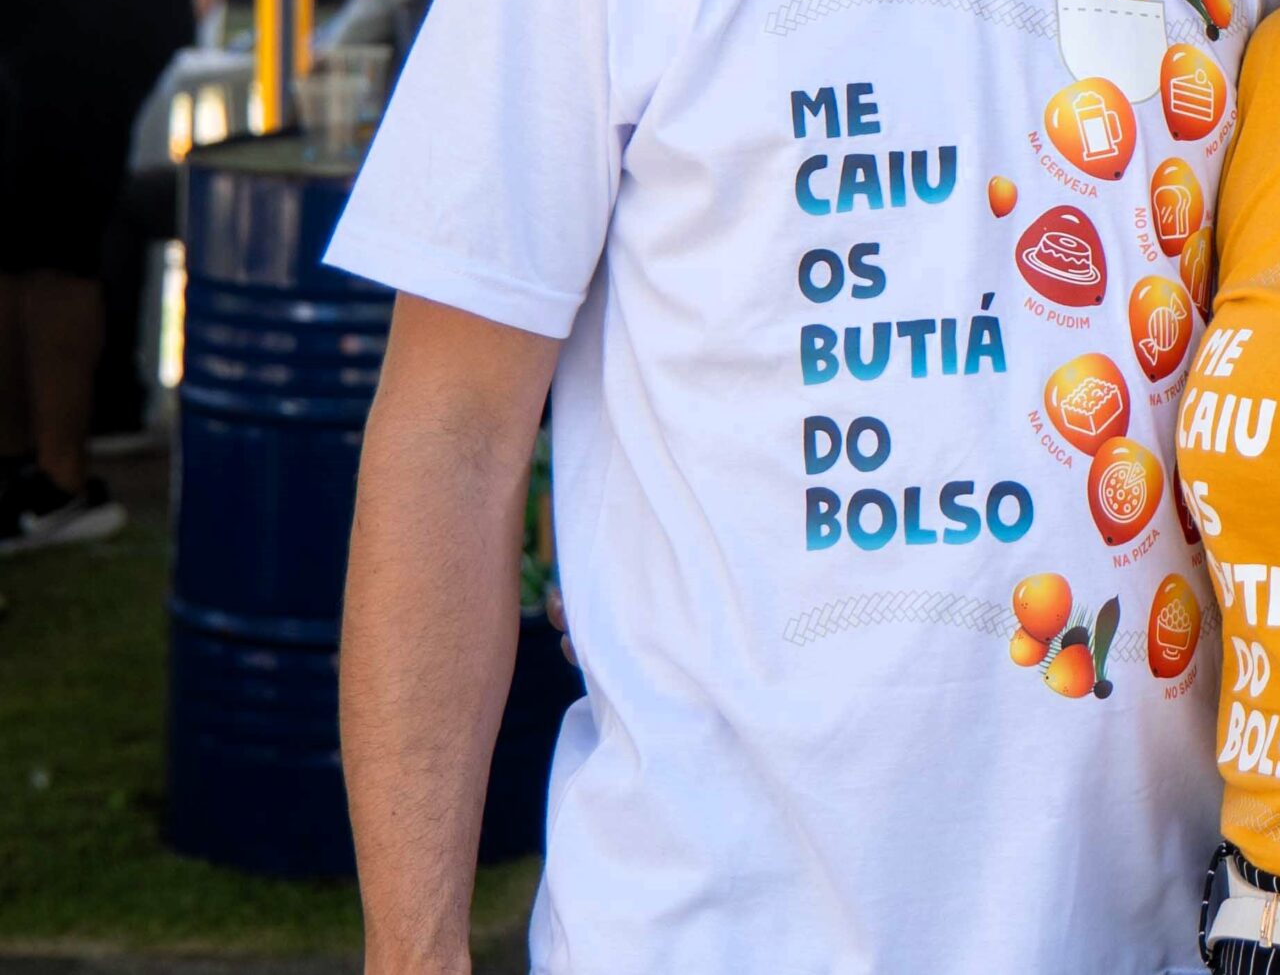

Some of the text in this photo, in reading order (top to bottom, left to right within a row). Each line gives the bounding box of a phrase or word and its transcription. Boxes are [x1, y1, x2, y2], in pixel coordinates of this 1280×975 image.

[791, 82, 881, 138] ME
[1028, 130, 1099, 198] NA CERVEJA
[1205, 140, 1218, 157] NO
[795, 145, 957, 216] CAIU
[1135, 207, 1158, 262] NO PÃO
[798, 242, 887, 303] OS
[800, 292, 1007, 385] BUTIÁ
[1024, 297, 1090, 329] NO PUDIM
[1195, 328, 1253, 376] ME
[1149, 393, 1162, 406] NA
[803, 415, 892, 475] DO
[1028, 410, 1073, 469] NA CUCA
[806, 480, 1035, 551] BOLSO
[1113, 529, 1160, 569] NA PIZZA
[1165, 686, 1178, 700] NO
[1231, 636, 1271, 698] DO
